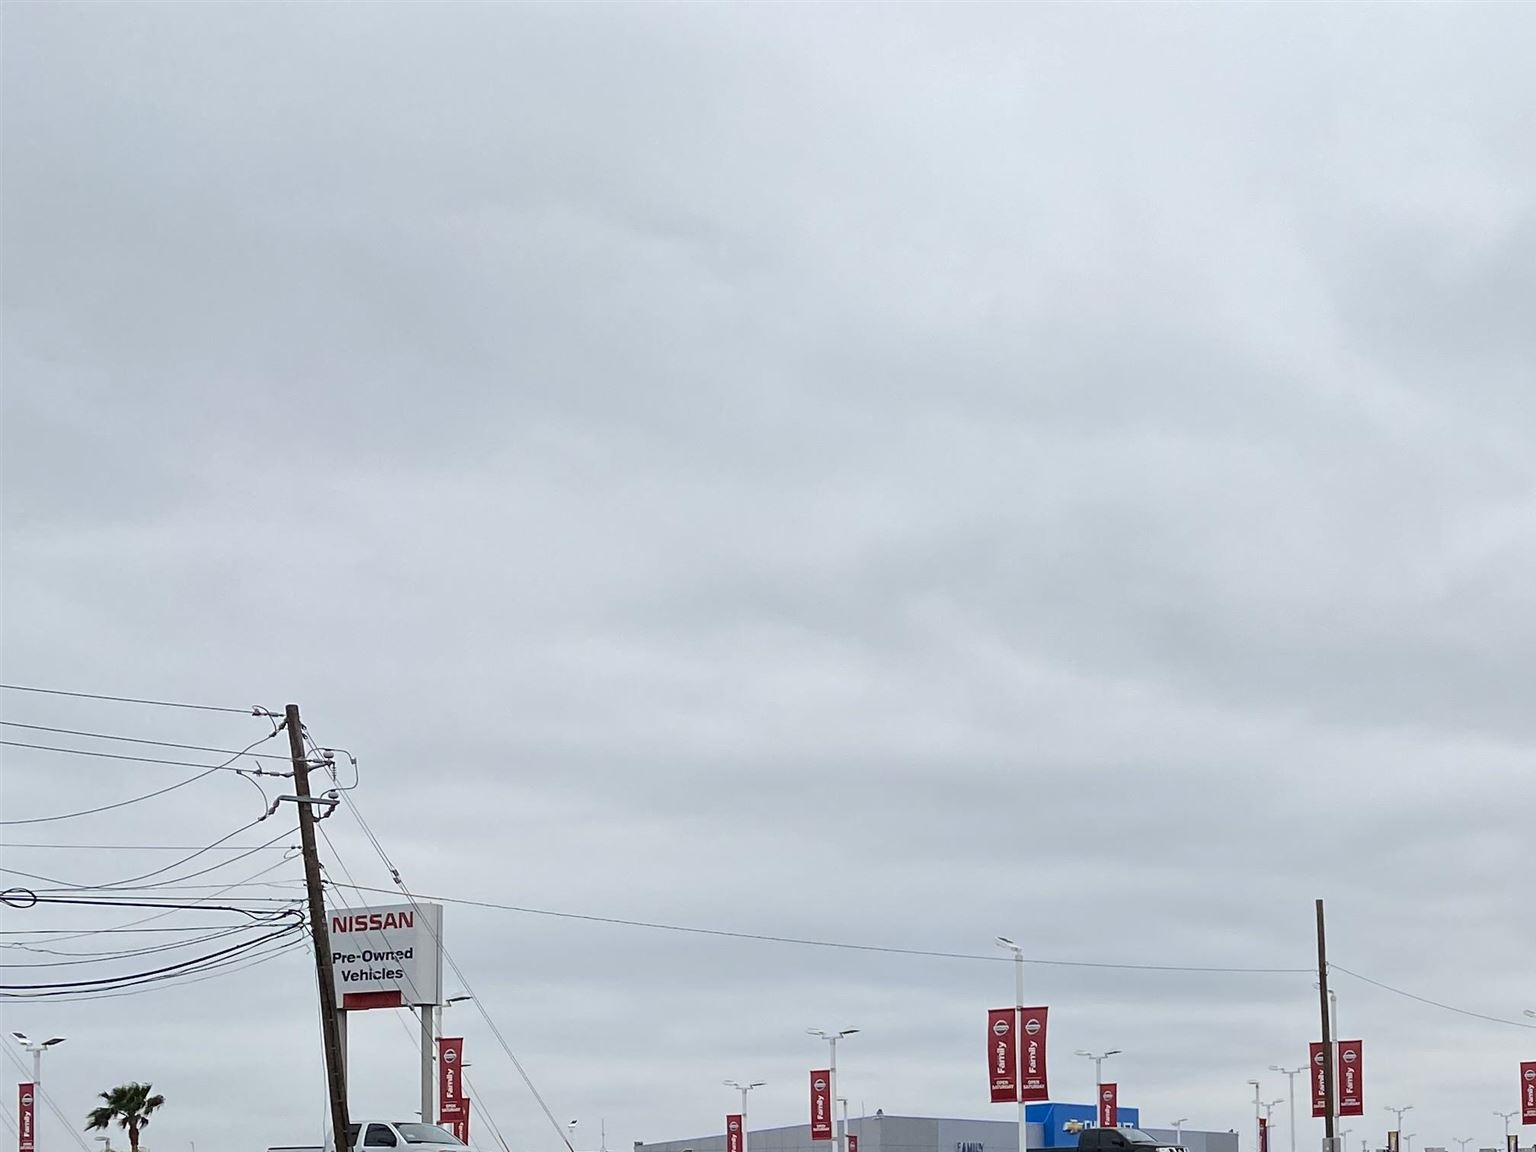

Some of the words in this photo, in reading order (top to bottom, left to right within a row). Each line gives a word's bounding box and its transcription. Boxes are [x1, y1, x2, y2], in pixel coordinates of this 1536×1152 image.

[333, 911, 414, 933] NISSAN
[333, 947, 413, 964] Pre-Owned
[342, 968, 403, 981] Vehicles
[997, 1041, 1007, 1074] Family
[1028, 1040, 1038, 1074] Family
[446, 1068, 454, 1098] Family
[1345, 1067, 1355, 1094] Family
[817, 1094, 825, 1120] Family
[1527, 1083, 1535, 1107] Family
